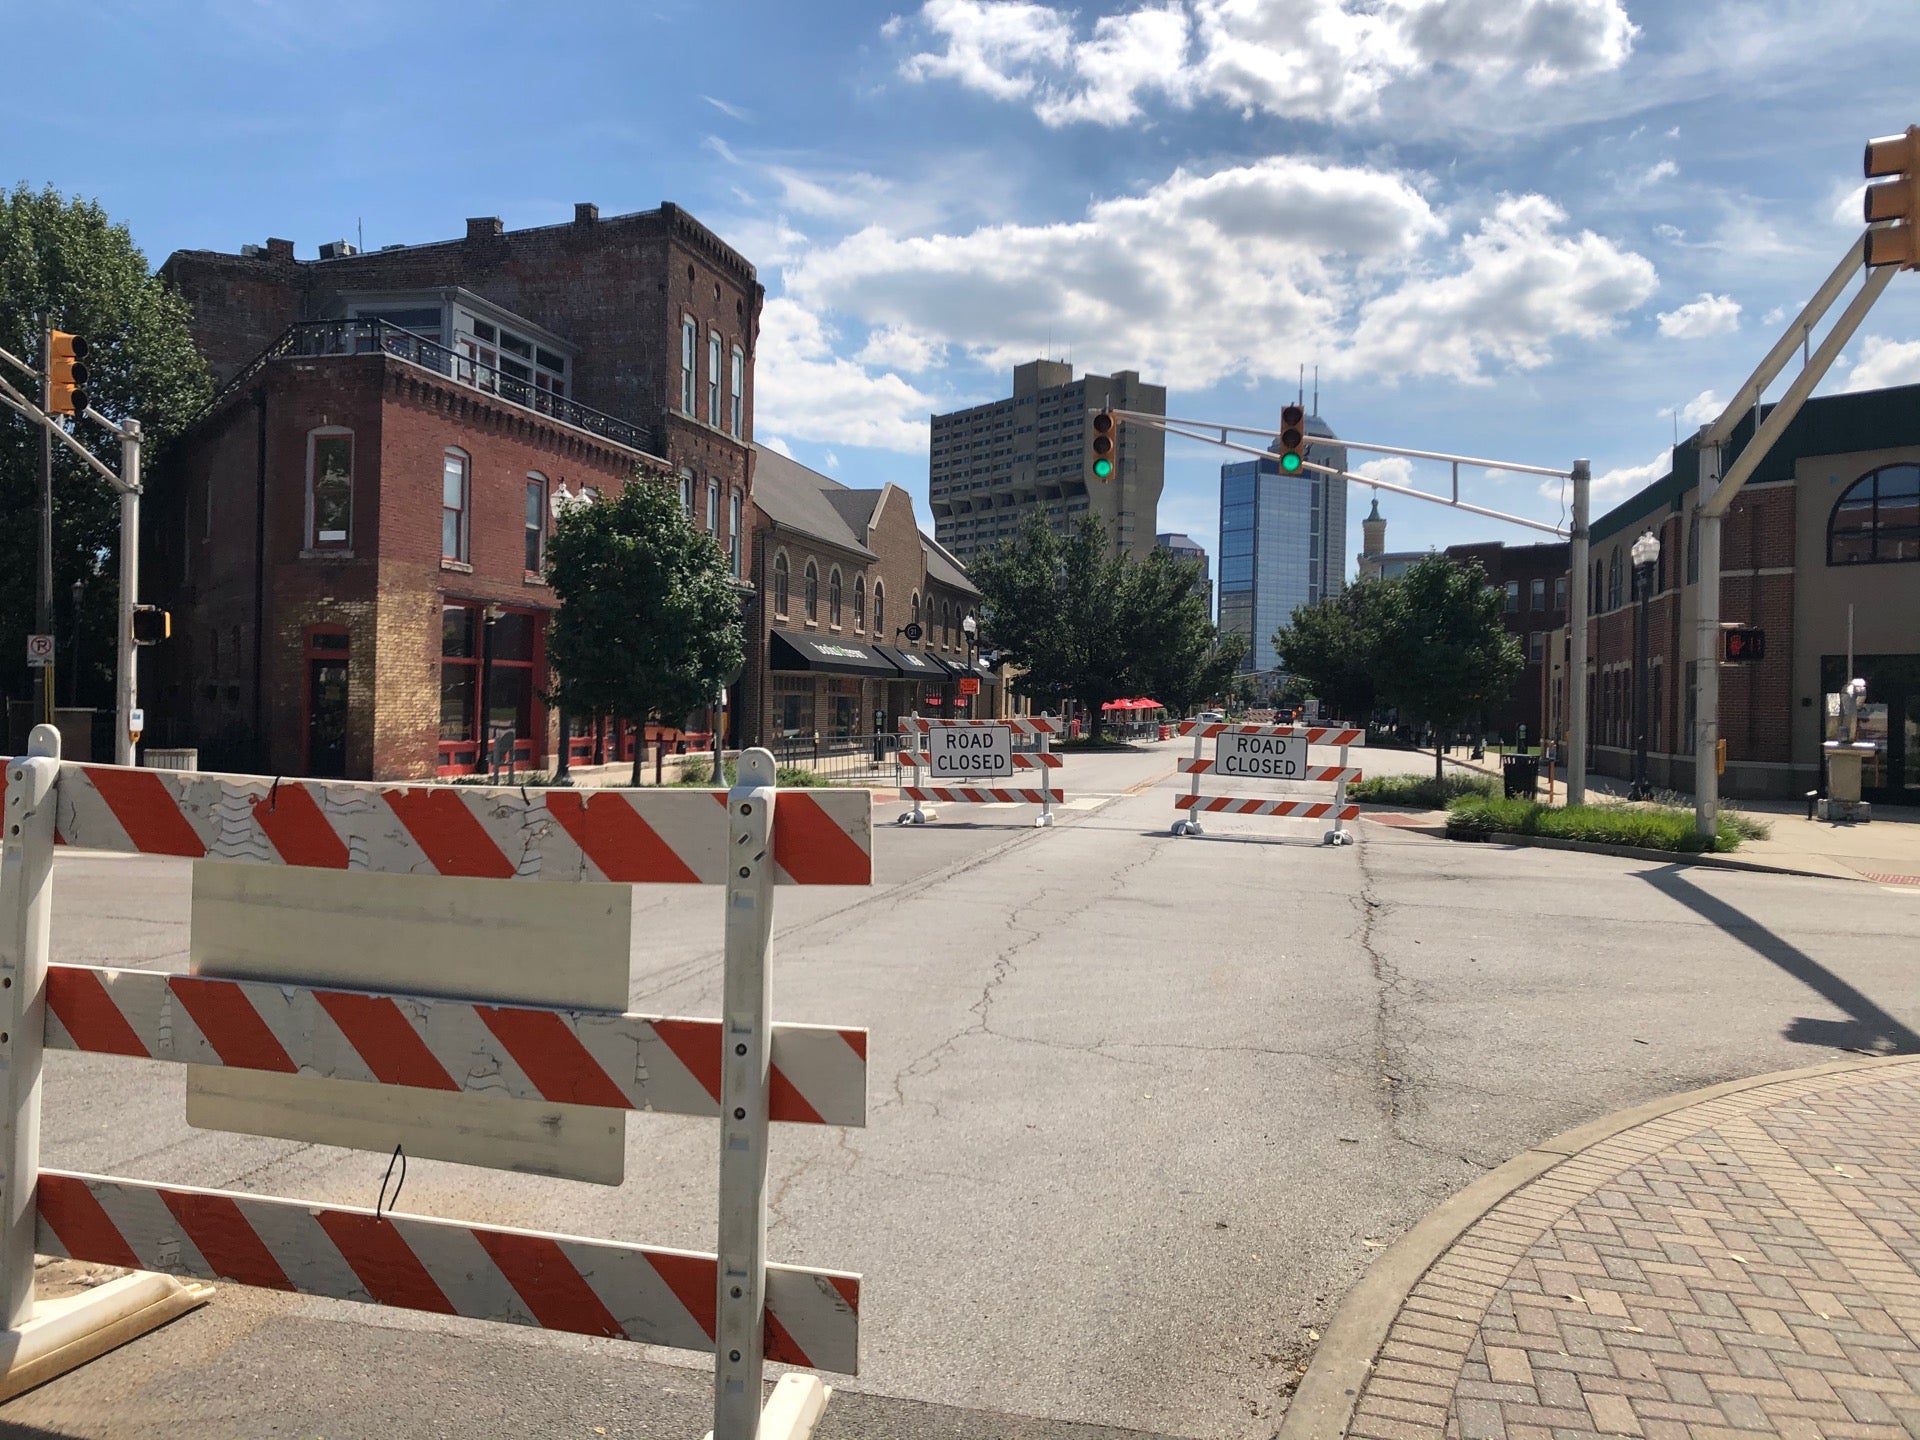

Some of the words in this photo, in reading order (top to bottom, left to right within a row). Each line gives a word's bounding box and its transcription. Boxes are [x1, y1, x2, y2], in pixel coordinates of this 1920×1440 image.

[946, 733, 994, 749] ROAD
[1237, 737, 1287, 755] ROAD
[937, 754, 1005, 770] CLOSED
[1225, 755, 1296, 775] CLOSED
